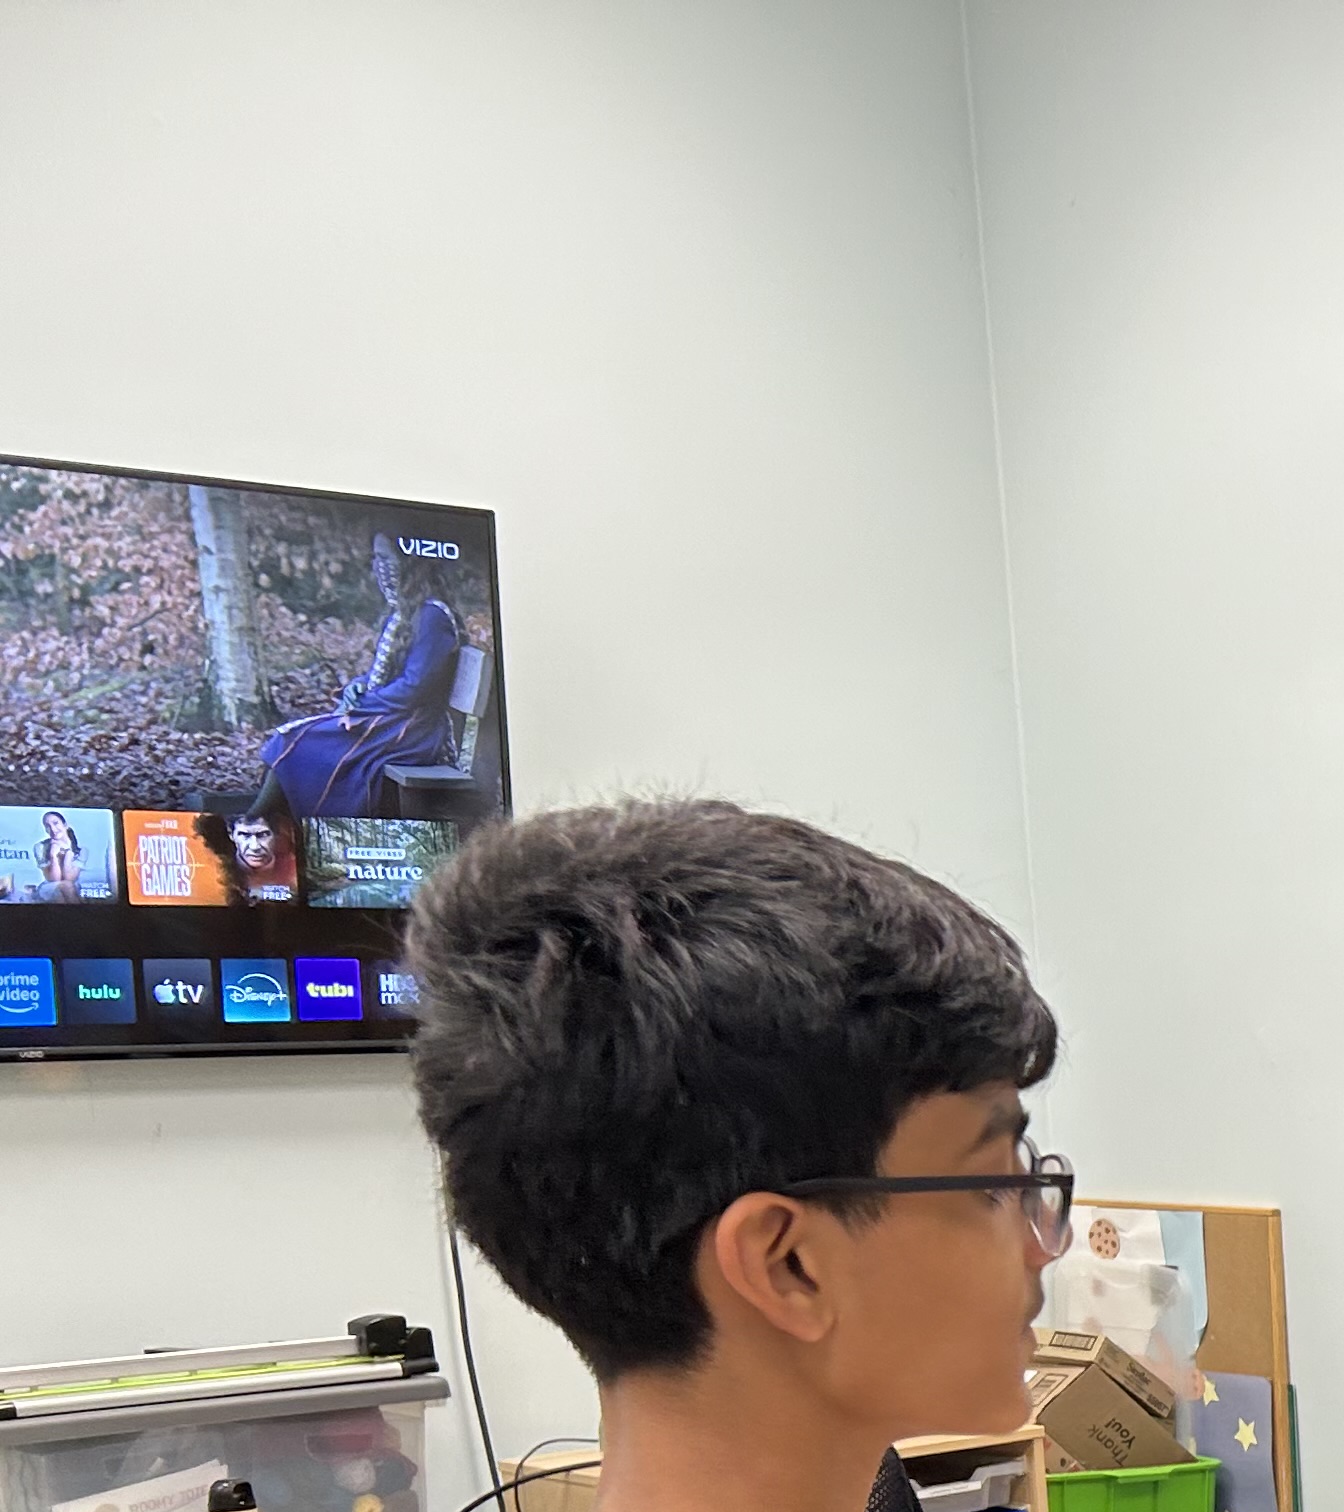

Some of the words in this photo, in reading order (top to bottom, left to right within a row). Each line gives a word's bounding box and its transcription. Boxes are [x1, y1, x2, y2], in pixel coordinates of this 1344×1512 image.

[398, 537, 460, 561] VIZIO
[139, 835, 188, 864] PATRIOT
[141, 863, 191, 896] GAMES
[348, 862, 423, 881] nature
[78, 984, 121, 1000] hulu
[176, 981, 204, 1004] tv
[306, 982, 354, 998] tubi
[1104, 1417, 1136, 1449] You!
[1088, 1424, 1128, 1467] Thank
